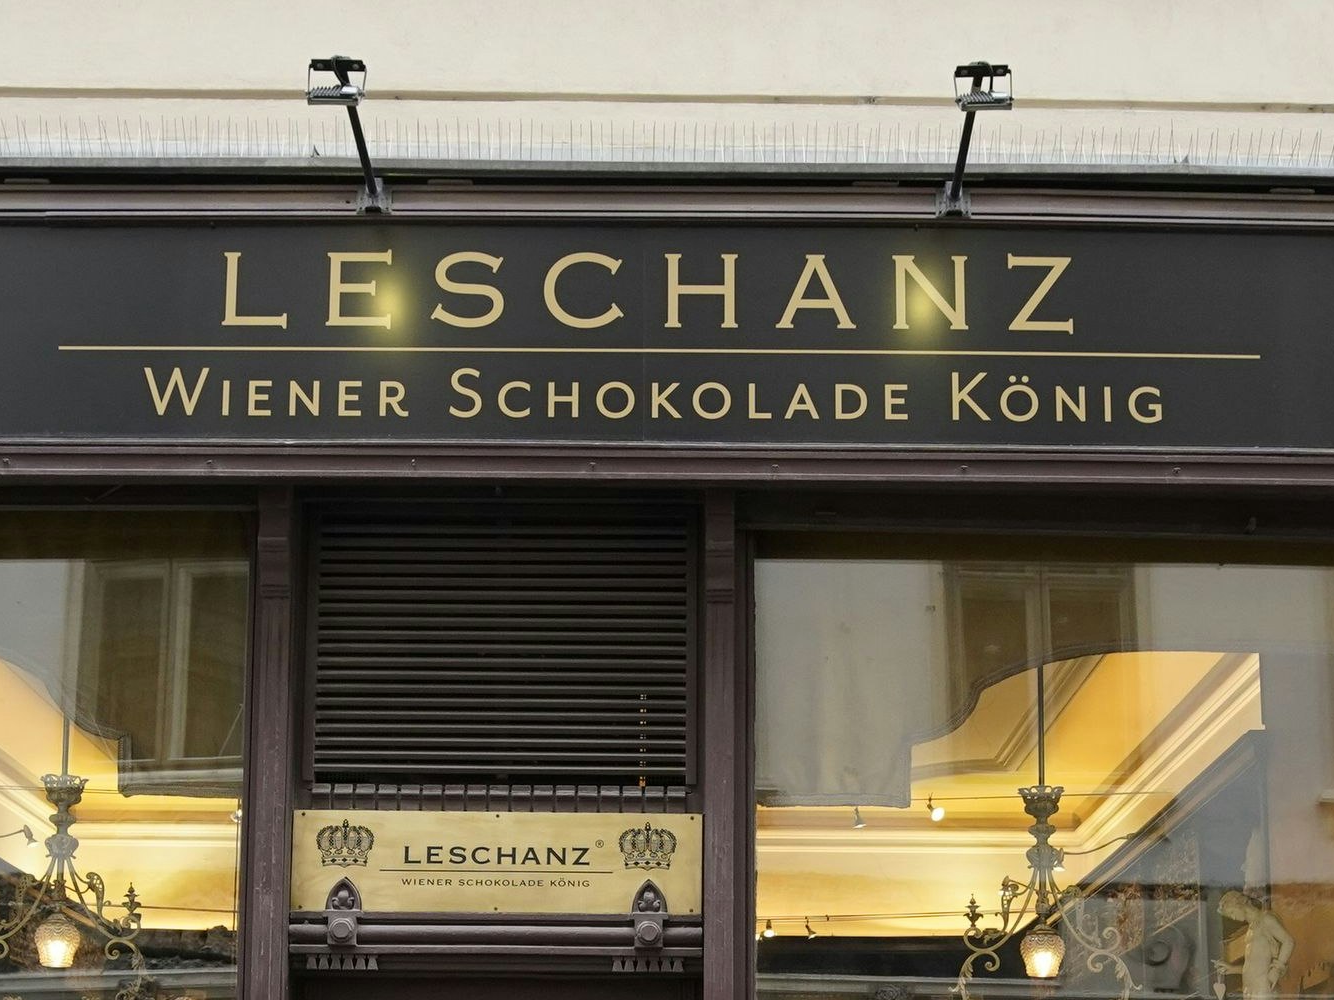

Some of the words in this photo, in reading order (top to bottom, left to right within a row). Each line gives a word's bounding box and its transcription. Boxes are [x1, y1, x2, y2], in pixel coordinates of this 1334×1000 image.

[221, 248, 1074, 335] LESCHANZ
[144, 366, 409, 417] WIENER
[449, 367, 909, 421] SCHOKOLADE
[951, 371, 1164, 424] KÖNIG
[401, 877, 453, 887] WIENER
[458, 878, 545, 888] SCHOKOLADE
[550, 876, 591, 888] KÖNIG
